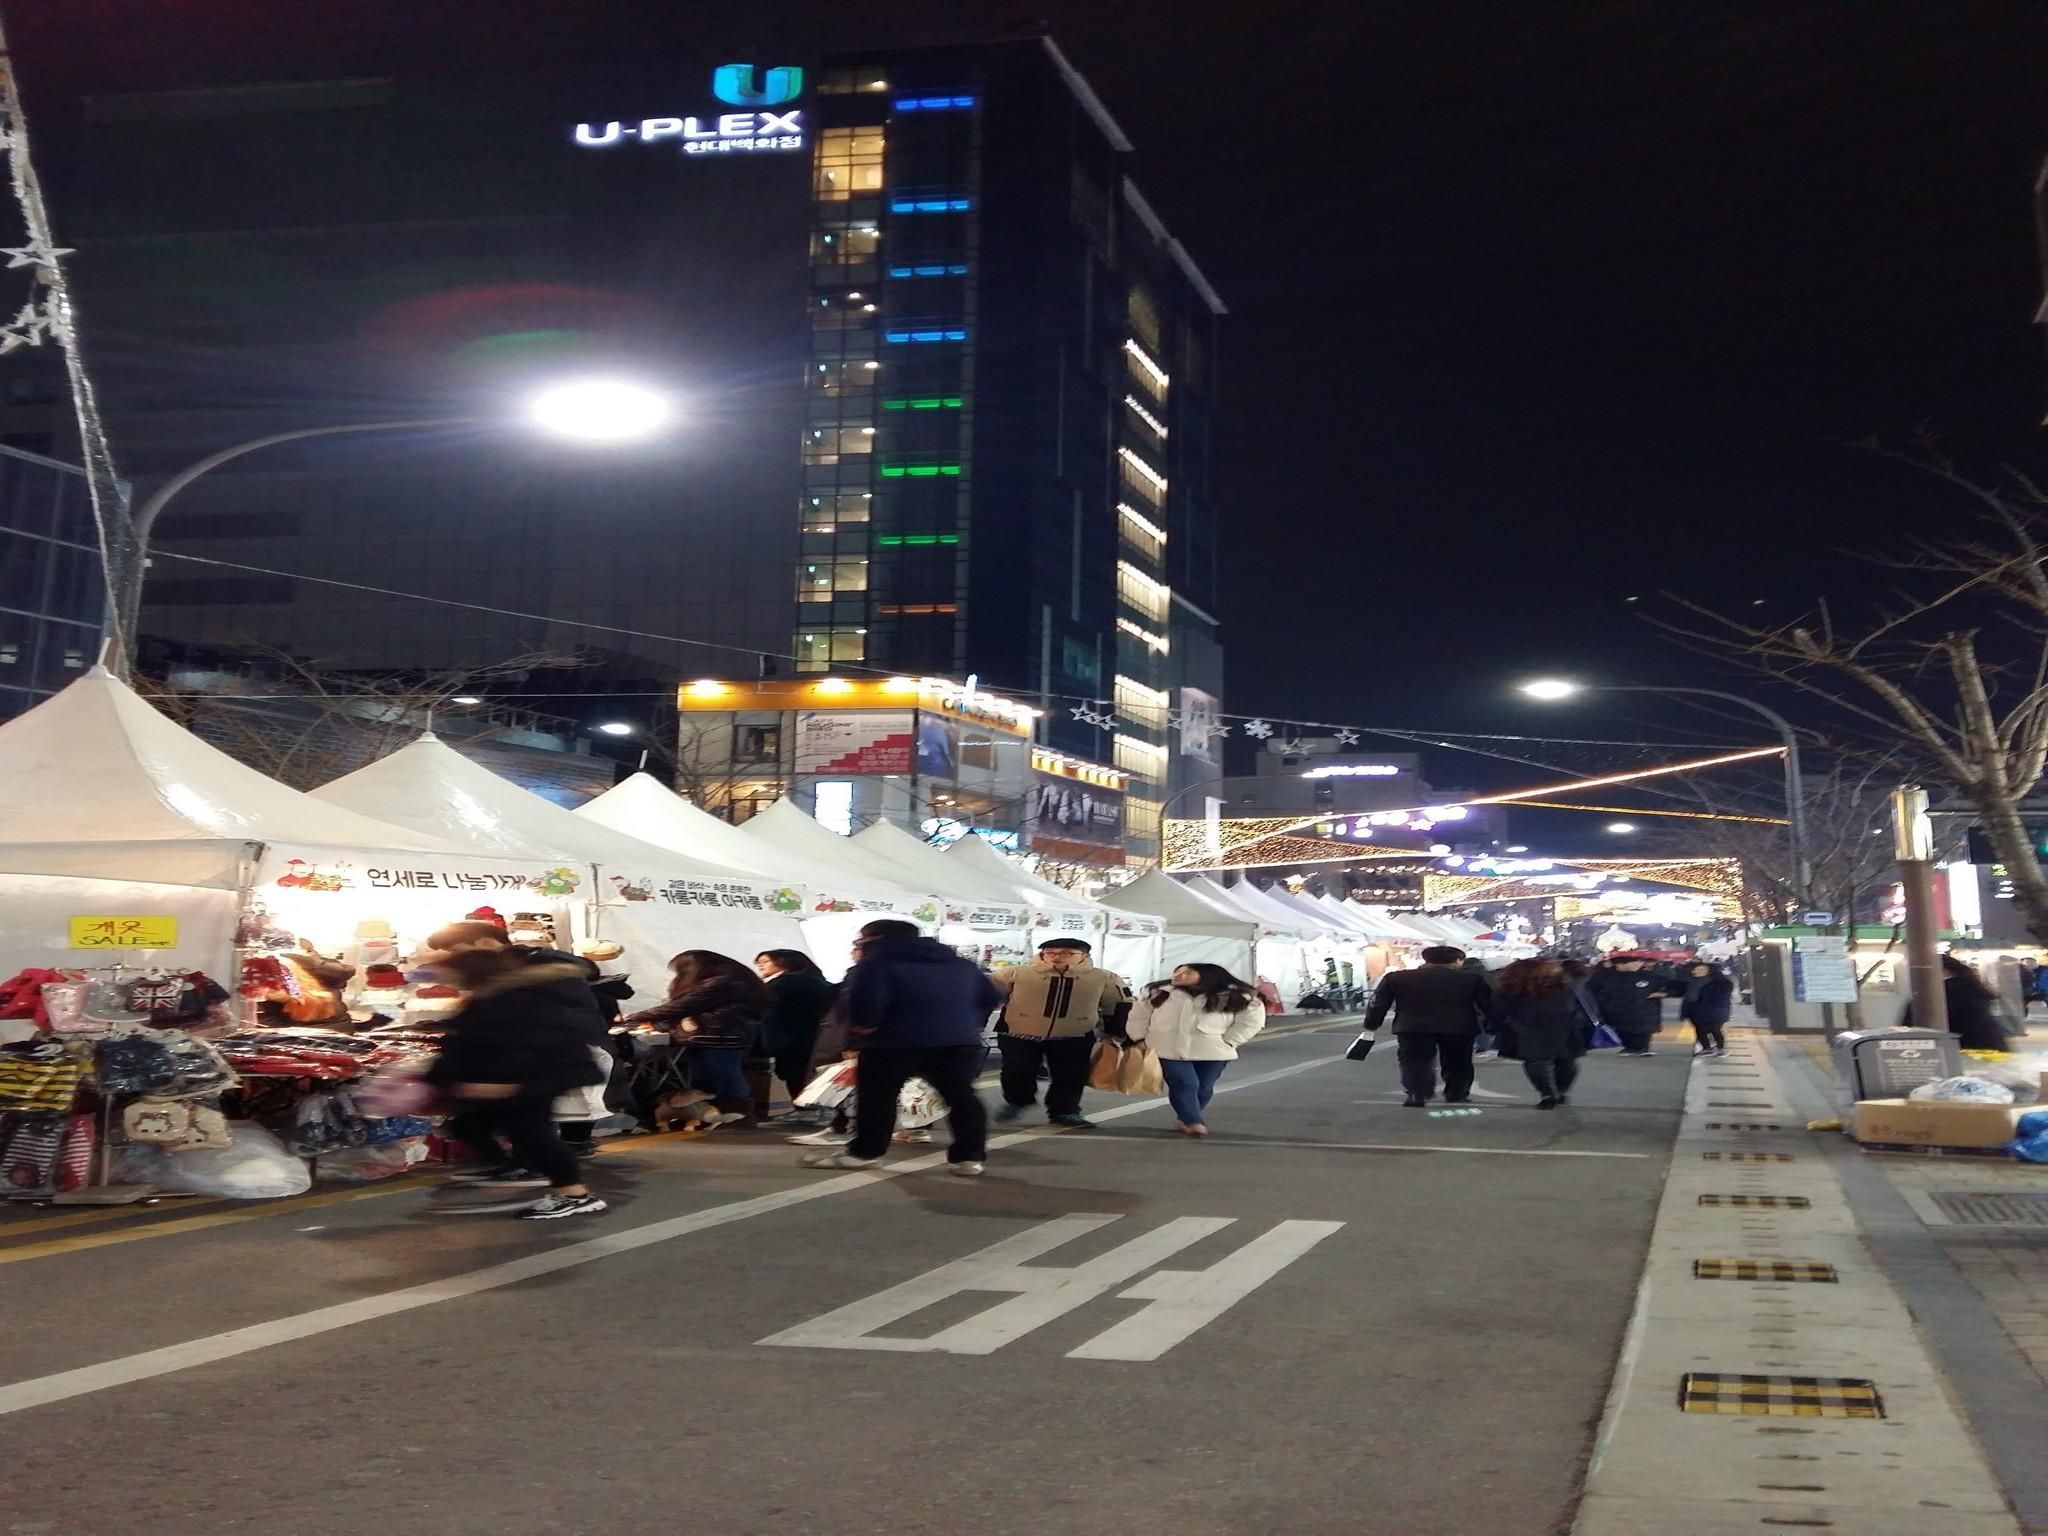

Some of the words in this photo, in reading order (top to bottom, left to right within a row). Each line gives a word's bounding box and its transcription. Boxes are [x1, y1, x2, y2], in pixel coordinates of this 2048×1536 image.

[575, 110, 802, 145] U-PLEX
[683, 135, 802, 154] 현대백화점
[366, 867, 438, 889] 연세로
[444, 872, 527, 892] 나눔가게
[722, 894, 763, 910] 마카롱
